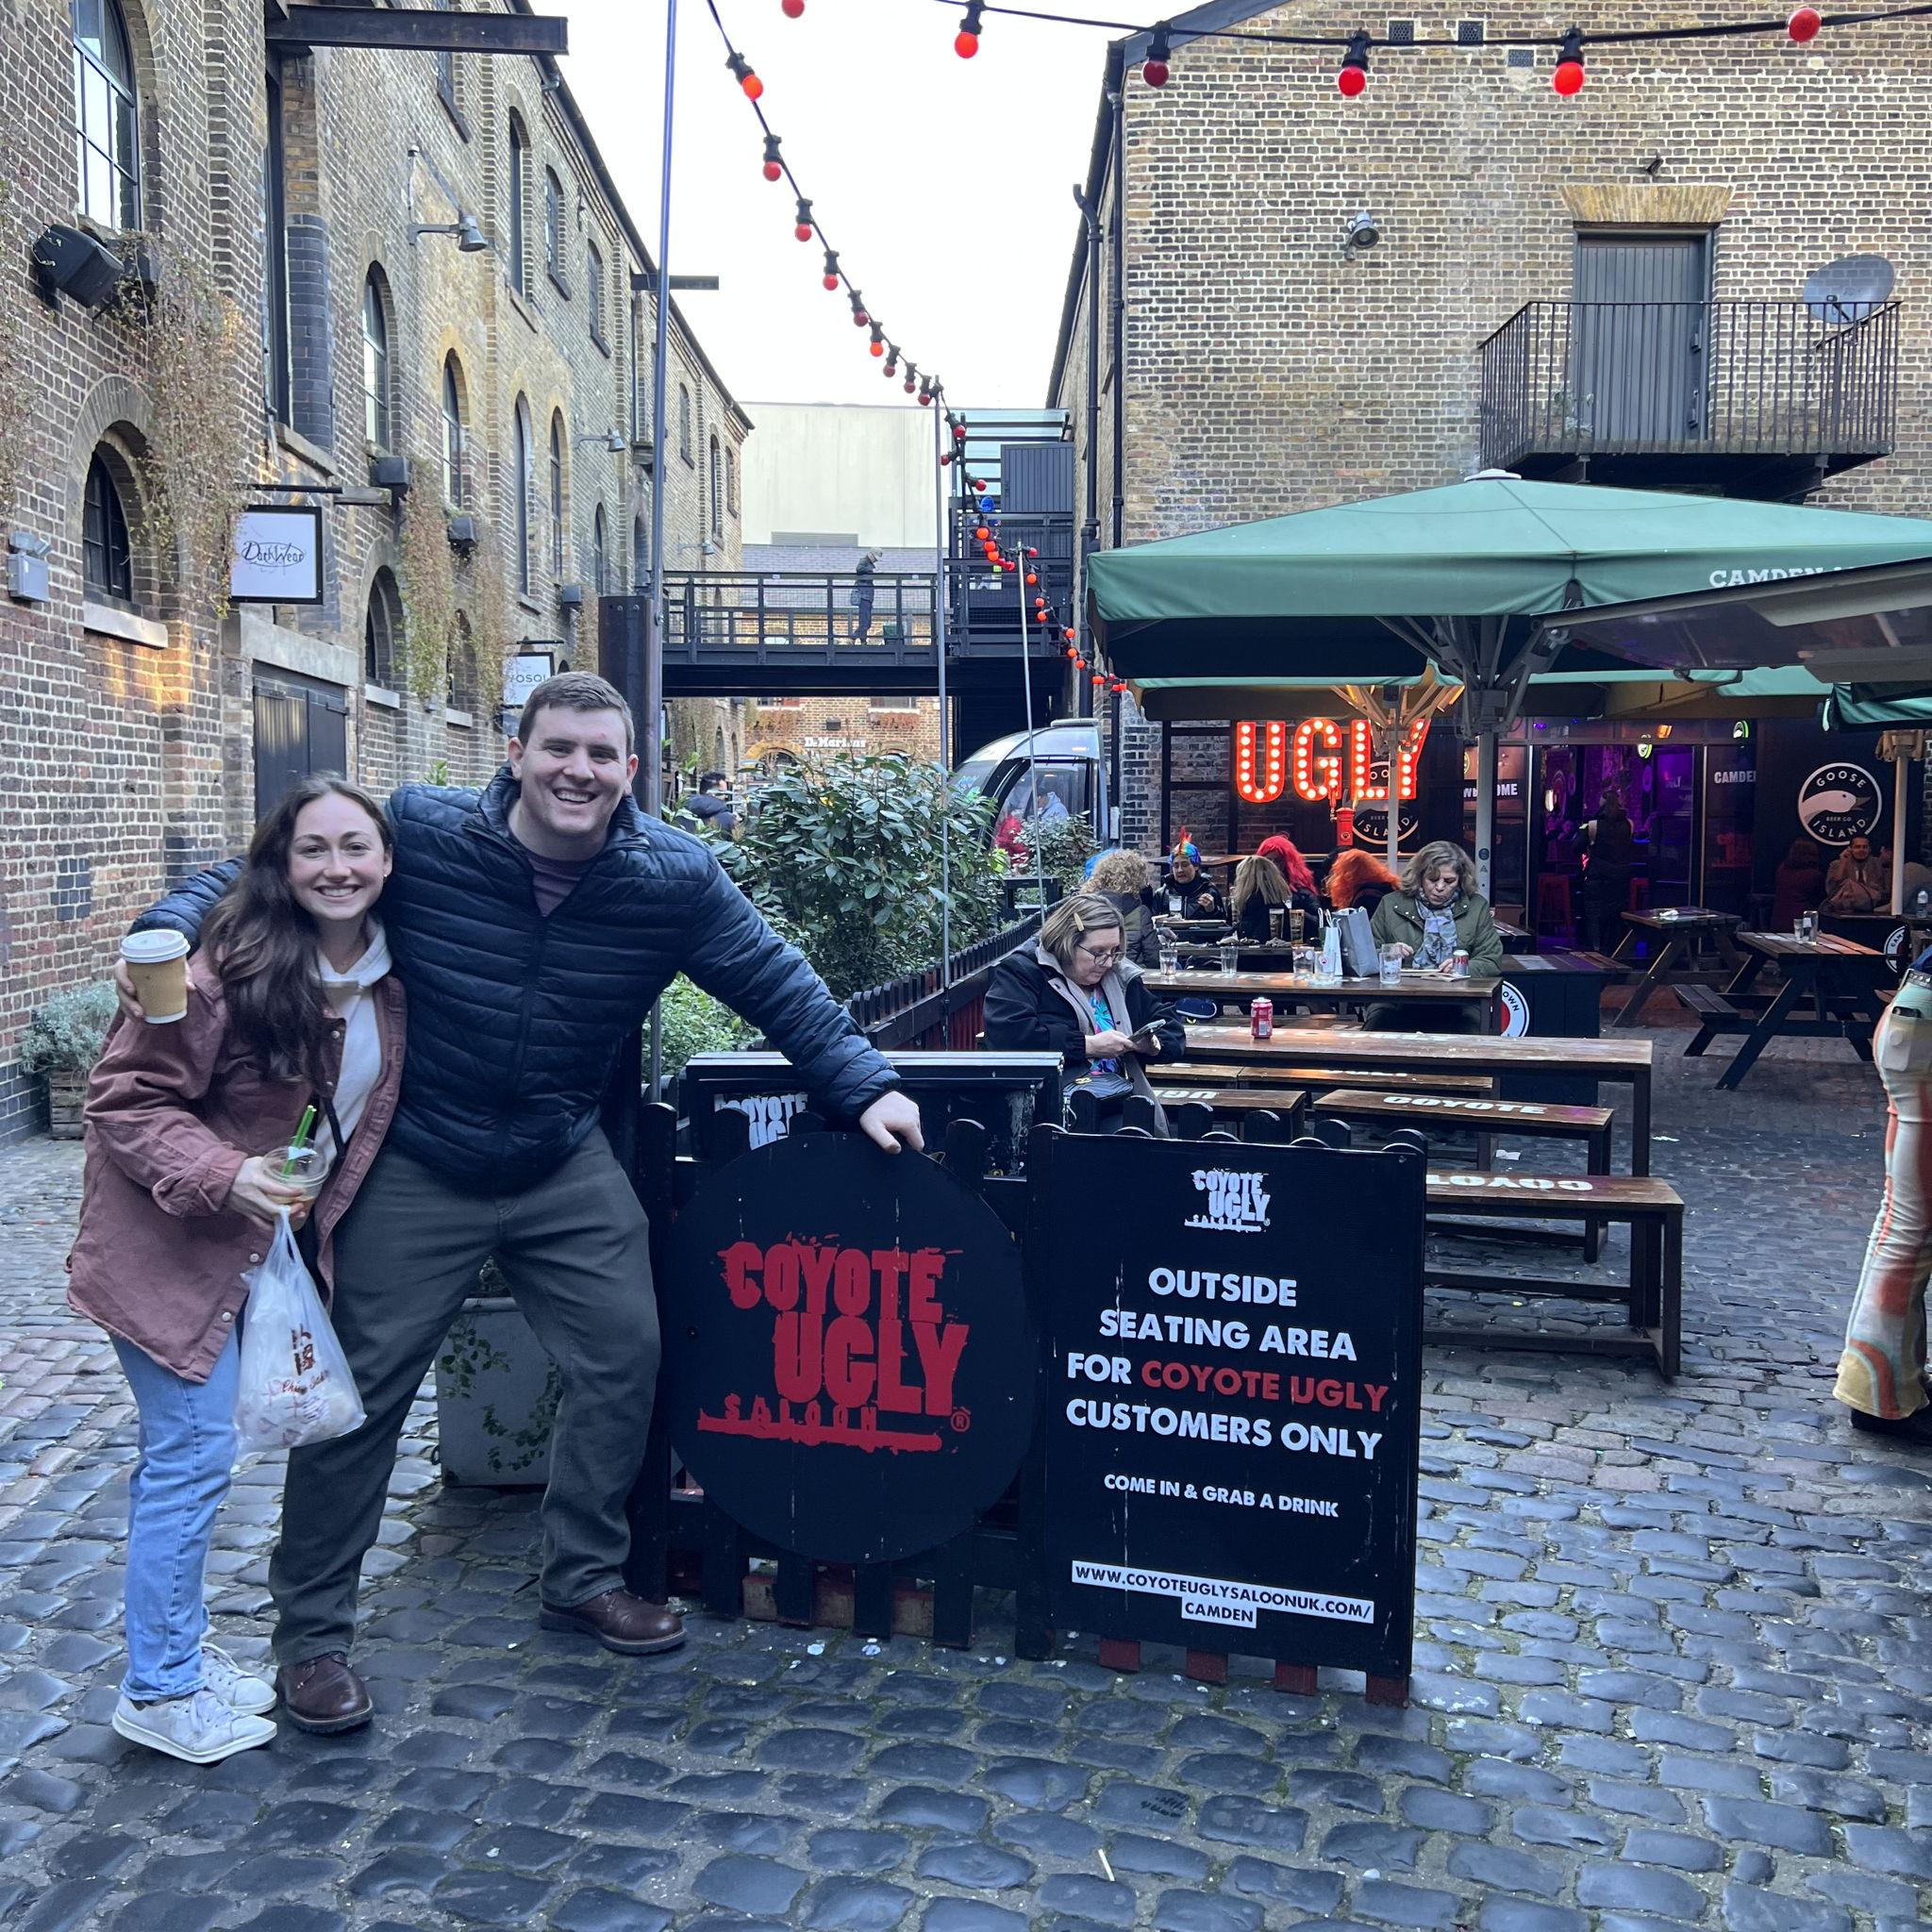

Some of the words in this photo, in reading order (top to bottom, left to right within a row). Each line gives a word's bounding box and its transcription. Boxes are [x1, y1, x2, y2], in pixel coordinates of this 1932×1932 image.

[1237, 717, 1432, 803] UGLY
[1816, 770, 1867, 789] GOOSE
[1357, 817, 1410, 837] ISLAD
[1812, 819, 1867, 839] ISLAND
[1502, 991, 1521, 1012] OWN
[1382, 1095, 1548, 1115] COYOTE
[1191, 1169, 1265, 1194] COYOTE
[1425, 1174, 1594, 1191] COYOT
[1208, 1191, 1271, 1222] UGLY
[720, 1239, 949, 1324] COYOTE
[1148, 1267, 1297, 1307] OUTSIDE
[1098, 1308, 1251, 1350] SEATING
[1258, 1324, 1357, 1361] AREA
[773, 1309, 970, 1416] UGLY
[1067, 1352, 1132, 1385] FOR
[1141, 1359, 1280, 1401] COYOTE
[1291, 1375, 1389, 1412] UGLY
[1066, 1398, 1273, 1448] CUSTOMERS
[1280, 1422, 1383, 1460] ONLY
[1103, 1474, 1157, 1494] COME
[1159, 1480, 1180, 1497] IN
[1183, 1483, 1198, 1500] &
[1202, 1486, 1256, 1507] GRAB
[1259, 1493, 1274, 1509] A
[1278, 1495, 1340, 1518] DRINK
[1074, 1565, 1372, 1620] WWW.COYOTEUGLYSALOONUK.COM/
[1184, 1601, 1255, 1623] CAMDEN
